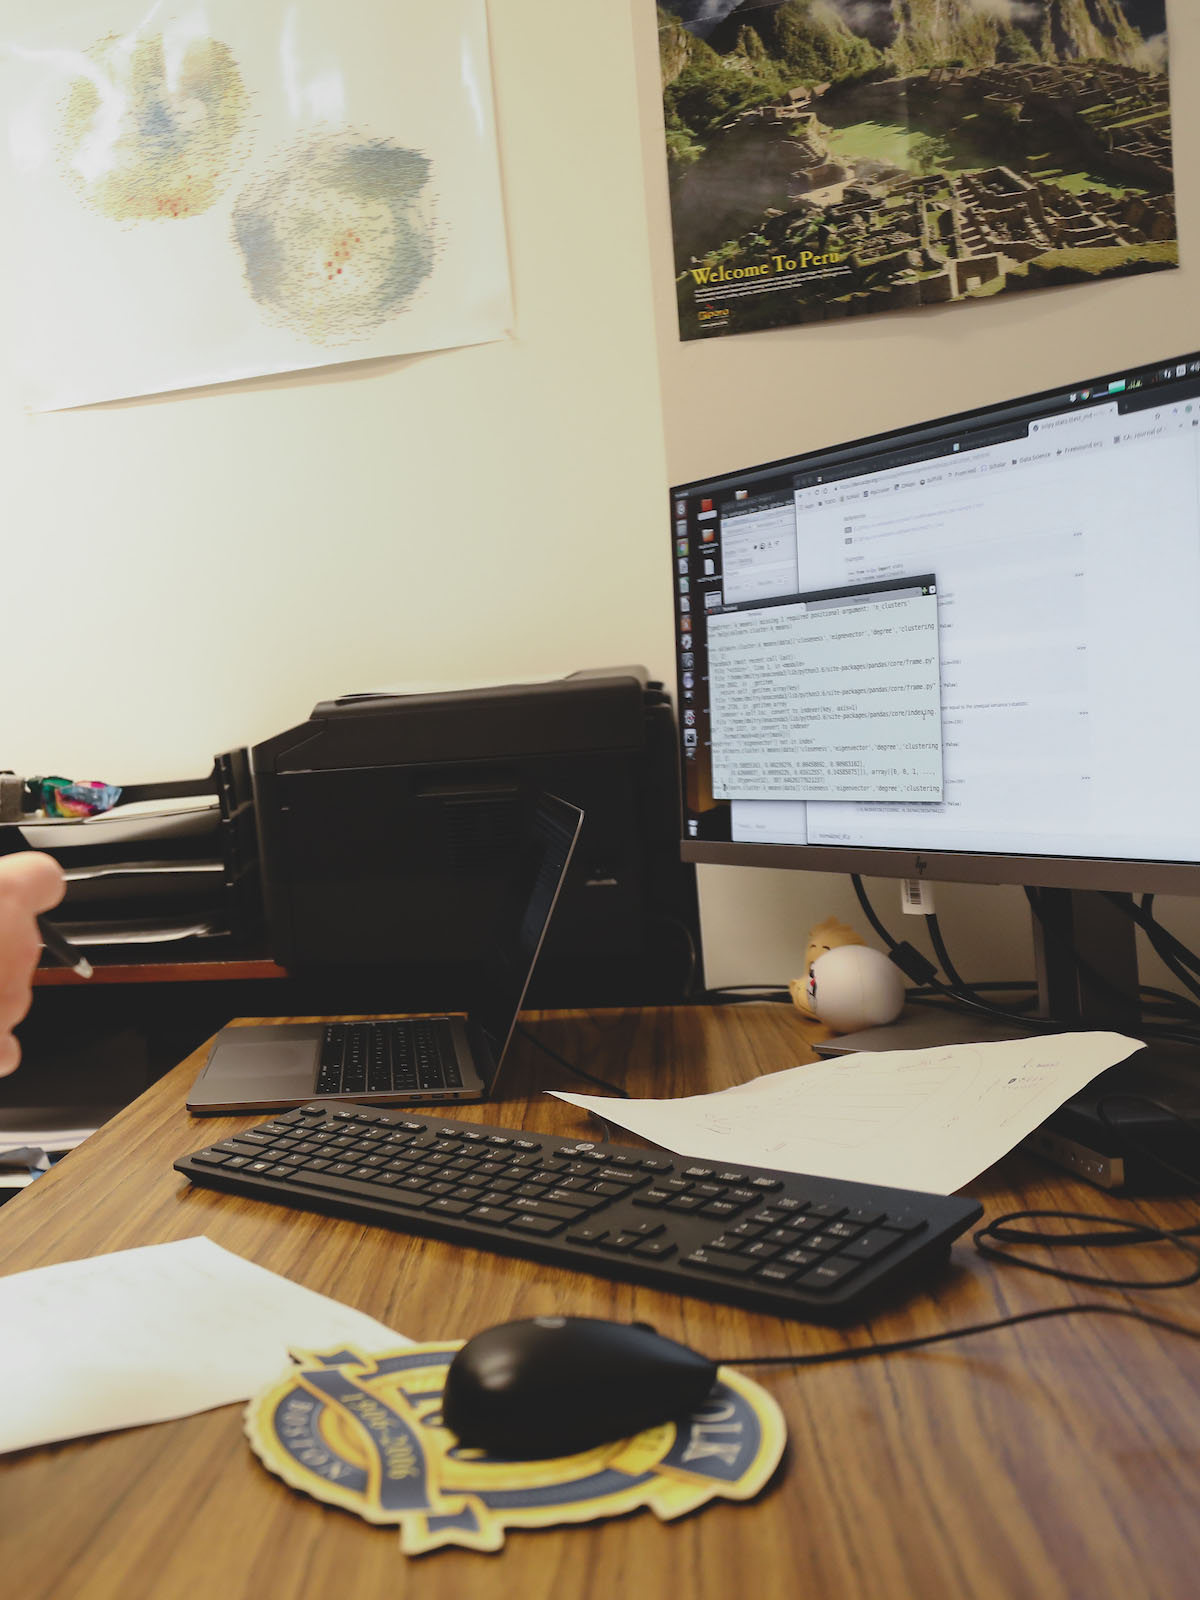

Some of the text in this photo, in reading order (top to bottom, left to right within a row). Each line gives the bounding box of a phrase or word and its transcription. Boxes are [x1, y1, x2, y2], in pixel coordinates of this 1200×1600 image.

[691, 251, 841, 285] Welcome To Peru
[682, 1398, 743, 1466] OLK
